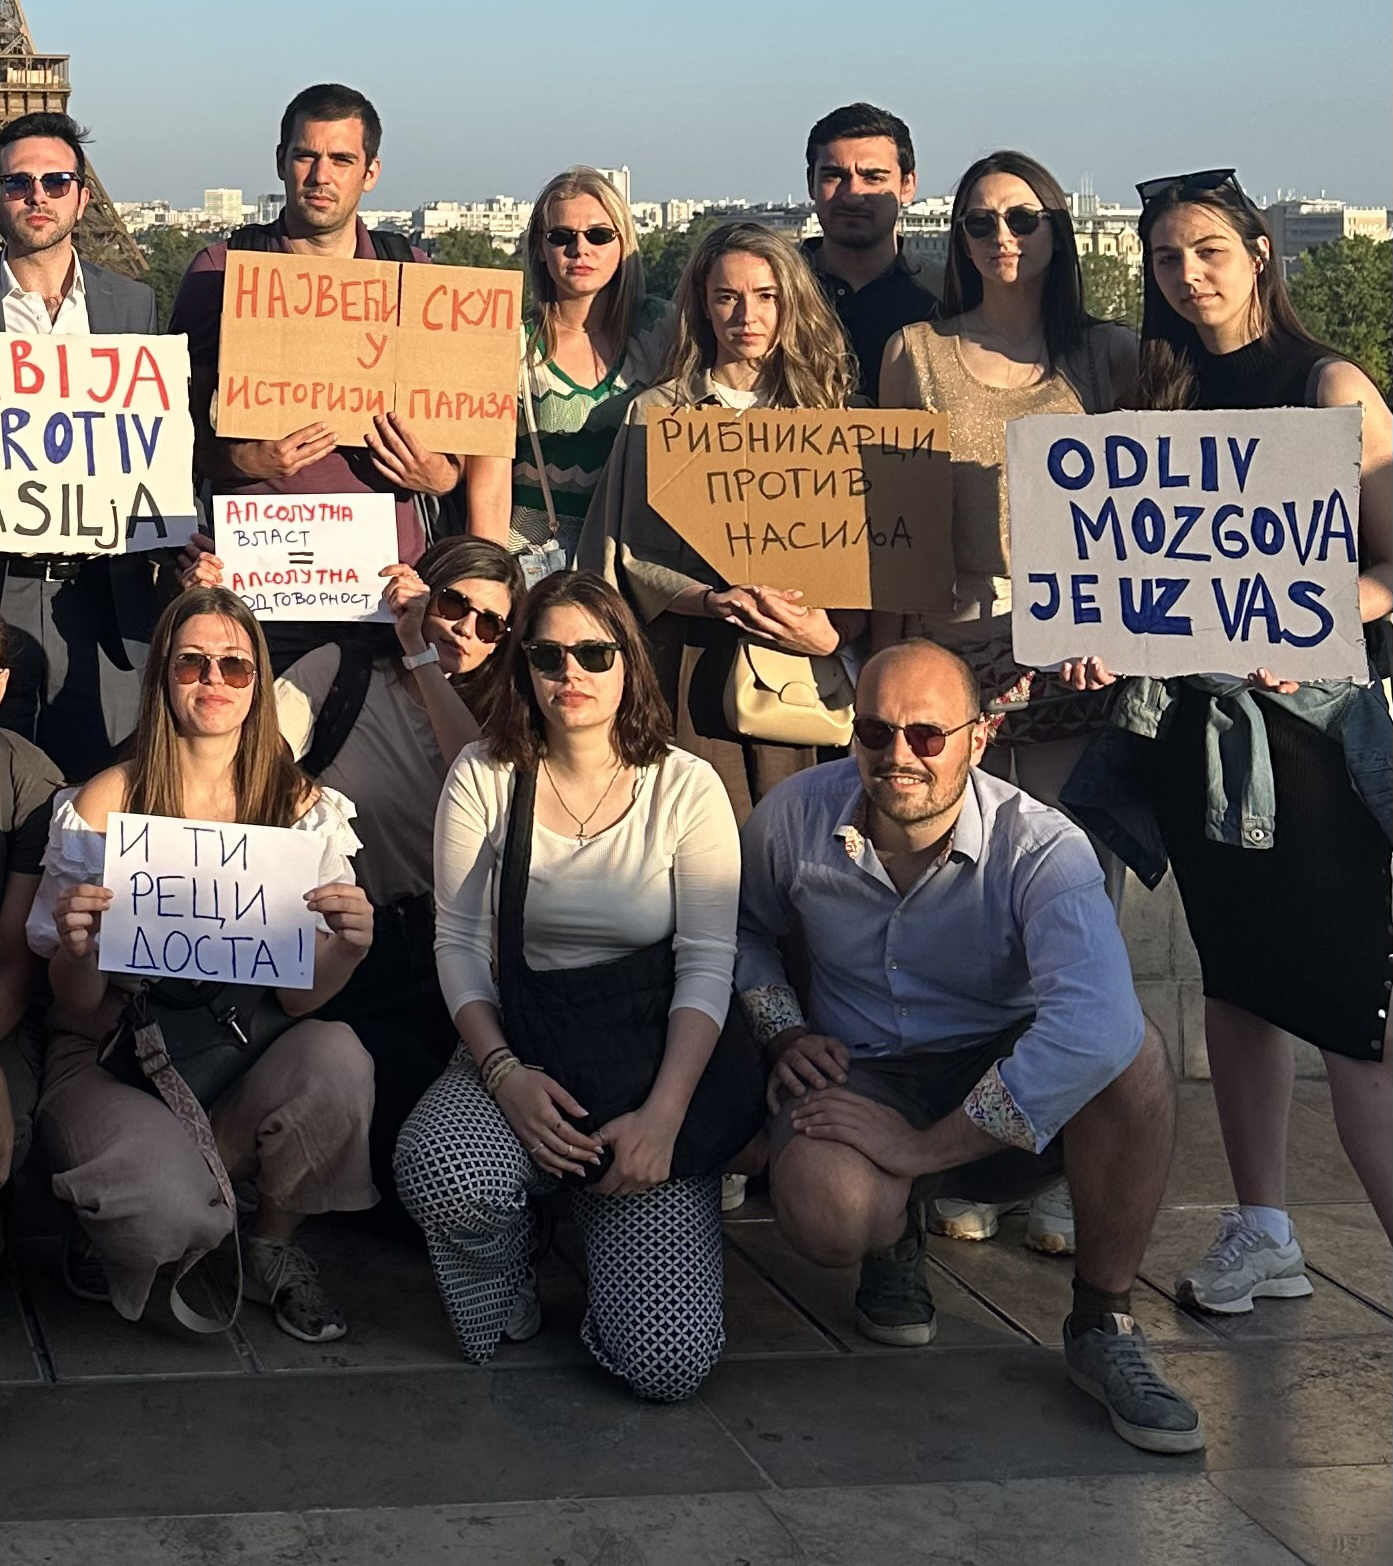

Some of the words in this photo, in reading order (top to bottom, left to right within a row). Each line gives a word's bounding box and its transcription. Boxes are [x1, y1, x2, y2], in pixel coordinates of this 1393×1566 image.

[422, 284, 514, 331] СКУП
[357, 332, 388, 369] У
[226, 375, 385, 416] ИСТОРИЈИ
[409, 387, 517, 422] ПАРИЗА
[658, 417, 935, 461] РИБНИКАРЦИ
[707, 467, 873, 504] ПРОТИВ
[1047, 435, 1260, 493] ODLIV
[226, 500, 353, 525] АПСОЛУТНА
[1069, 488, 1357, 566] MOZGOVA
[233, 528, 310, 547] ВЛАСТ
[725, 516, 913, 557] НАСИЉА
[232, 568, 359, 592] АПСОЛУТНА
[1028, 572, 1102, 625] JE
[1119, 577, 1193, 636] UZ
[1211, 572, 1334, 648] VAS
[120, 820, 149, 863] И
[183, 826, 247, 871] ТИ
[130, 871, 266, 930] РЕЦИ
